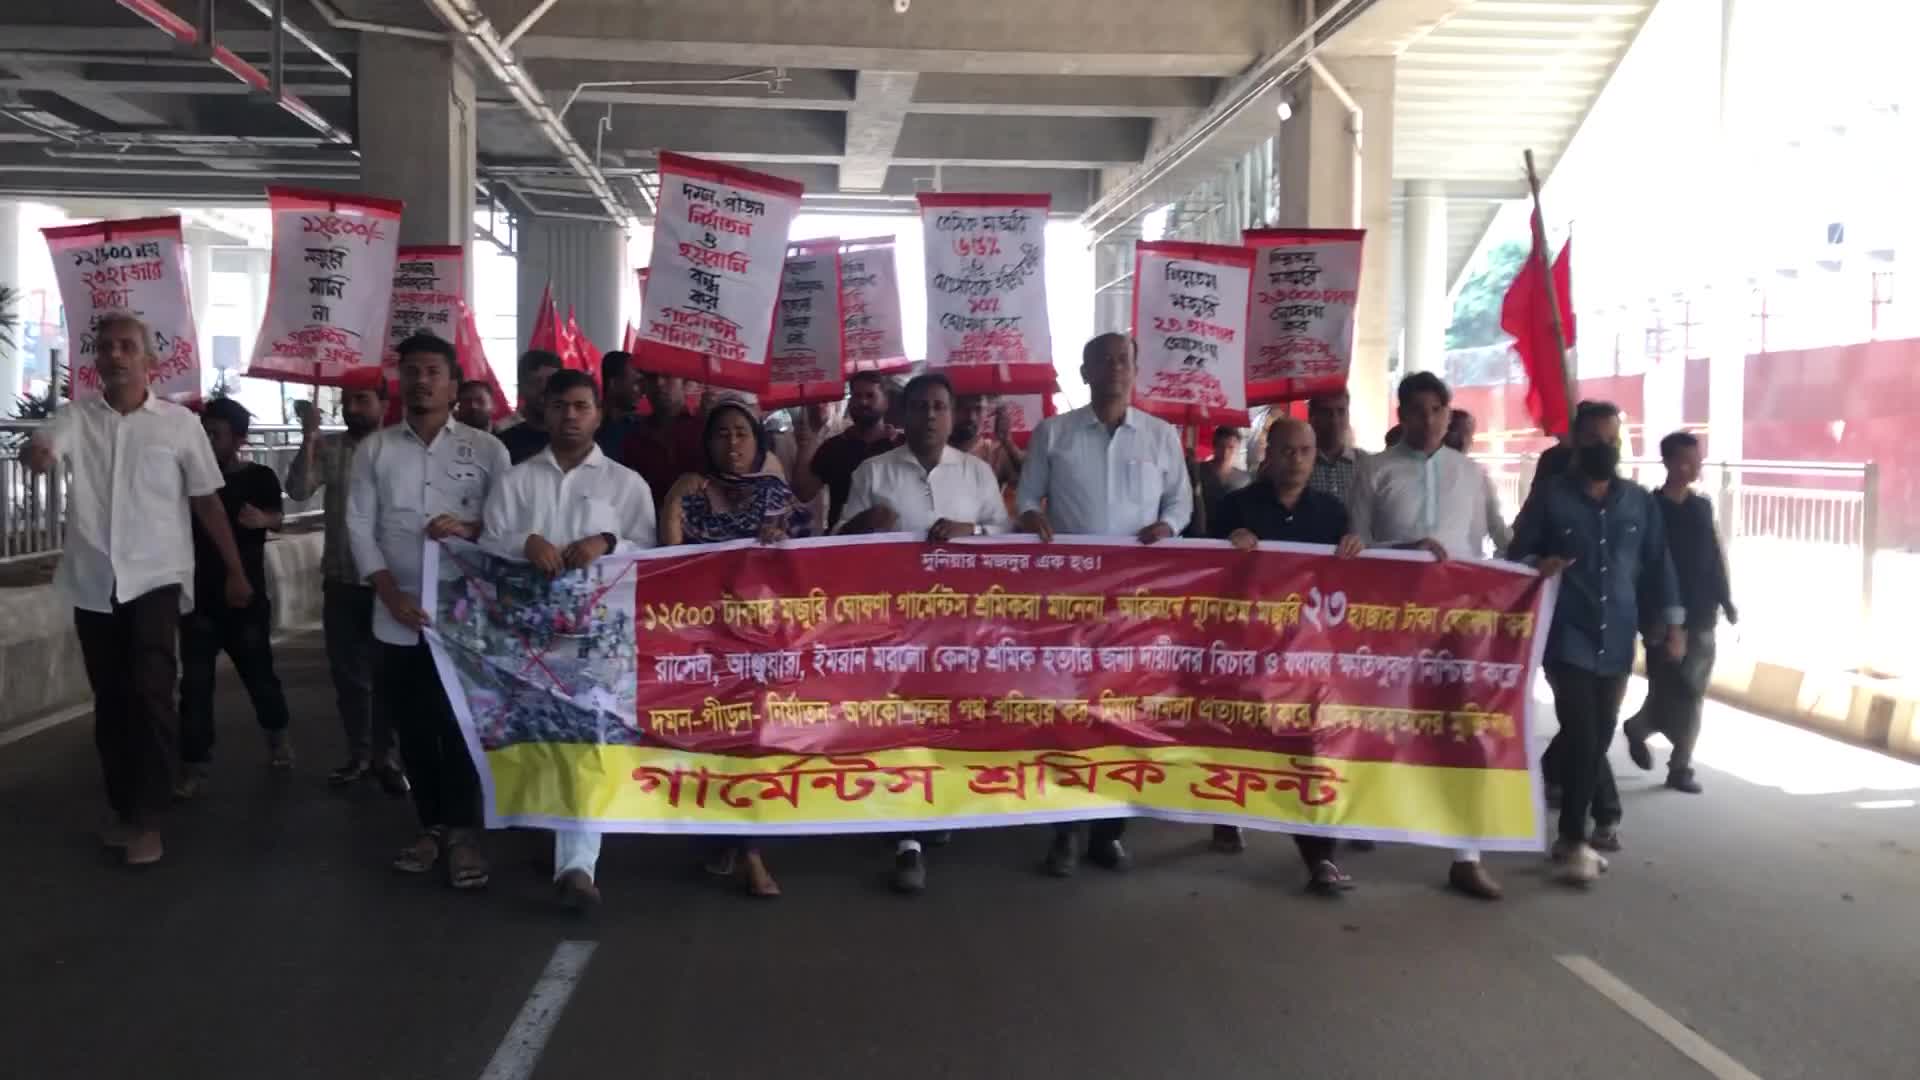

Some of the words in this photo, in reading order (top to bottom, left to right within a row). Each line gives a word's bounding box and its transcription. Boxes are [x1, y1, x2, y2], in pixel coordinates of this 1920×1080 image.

[309, 275, 351, 299] মানি
[688, 288, 720, 310] কর
[311, 304, 331, 322] না
[922, 548, 976, 572] দুনিয়ার
[981, 554, 1031, 573] মজদুর
[1035, 554, 1065, 570] এক
[645, 602, 714, 632] ১২৫০০
[722, 592, 775, 628] টাকার
[779, 588, 829, 630] মজুরি
[833, 593, 892, 626] ঘোষণা
[896, 584, 968, 619] গার্মেন্টস
[974, 584, 1041, 620] শ্রমিকরা
[1256, 592, 1300, 634] মজুরি
[1302, 586, 1347, 633] ২৩
[1348, 603, 1399, 631] হাজার
[1400, 602, 1440, 633] টাকা
[654, 653, 720, 687] রাসেল,
[813, 643, 868, 677] ইমরান
[935, 646, 981, 673] কেন?
[984, 637, 1036, 673] শ্রমিক
[1041, 646, 1093, 673] হত্যার
[1097, 646, 1134, 673] জন্য
[1210, 640, 1256, 676] বিচার
[1264, 652, 1280, 674] ও
[1418, 648, 1477, 684] নিশ্চিত
[959, 700, 988, 723] পথ
[992, 689, 1056, 728] পরিহার
[1199, 697, 1273, 733] প্রত্যাহার
[631, 755, 942, 809] গার্মেন্টস
[967, 751, 1167, 801] শ্রমিক
[1190, 758, 1347, 808] ফ্রন্ট
